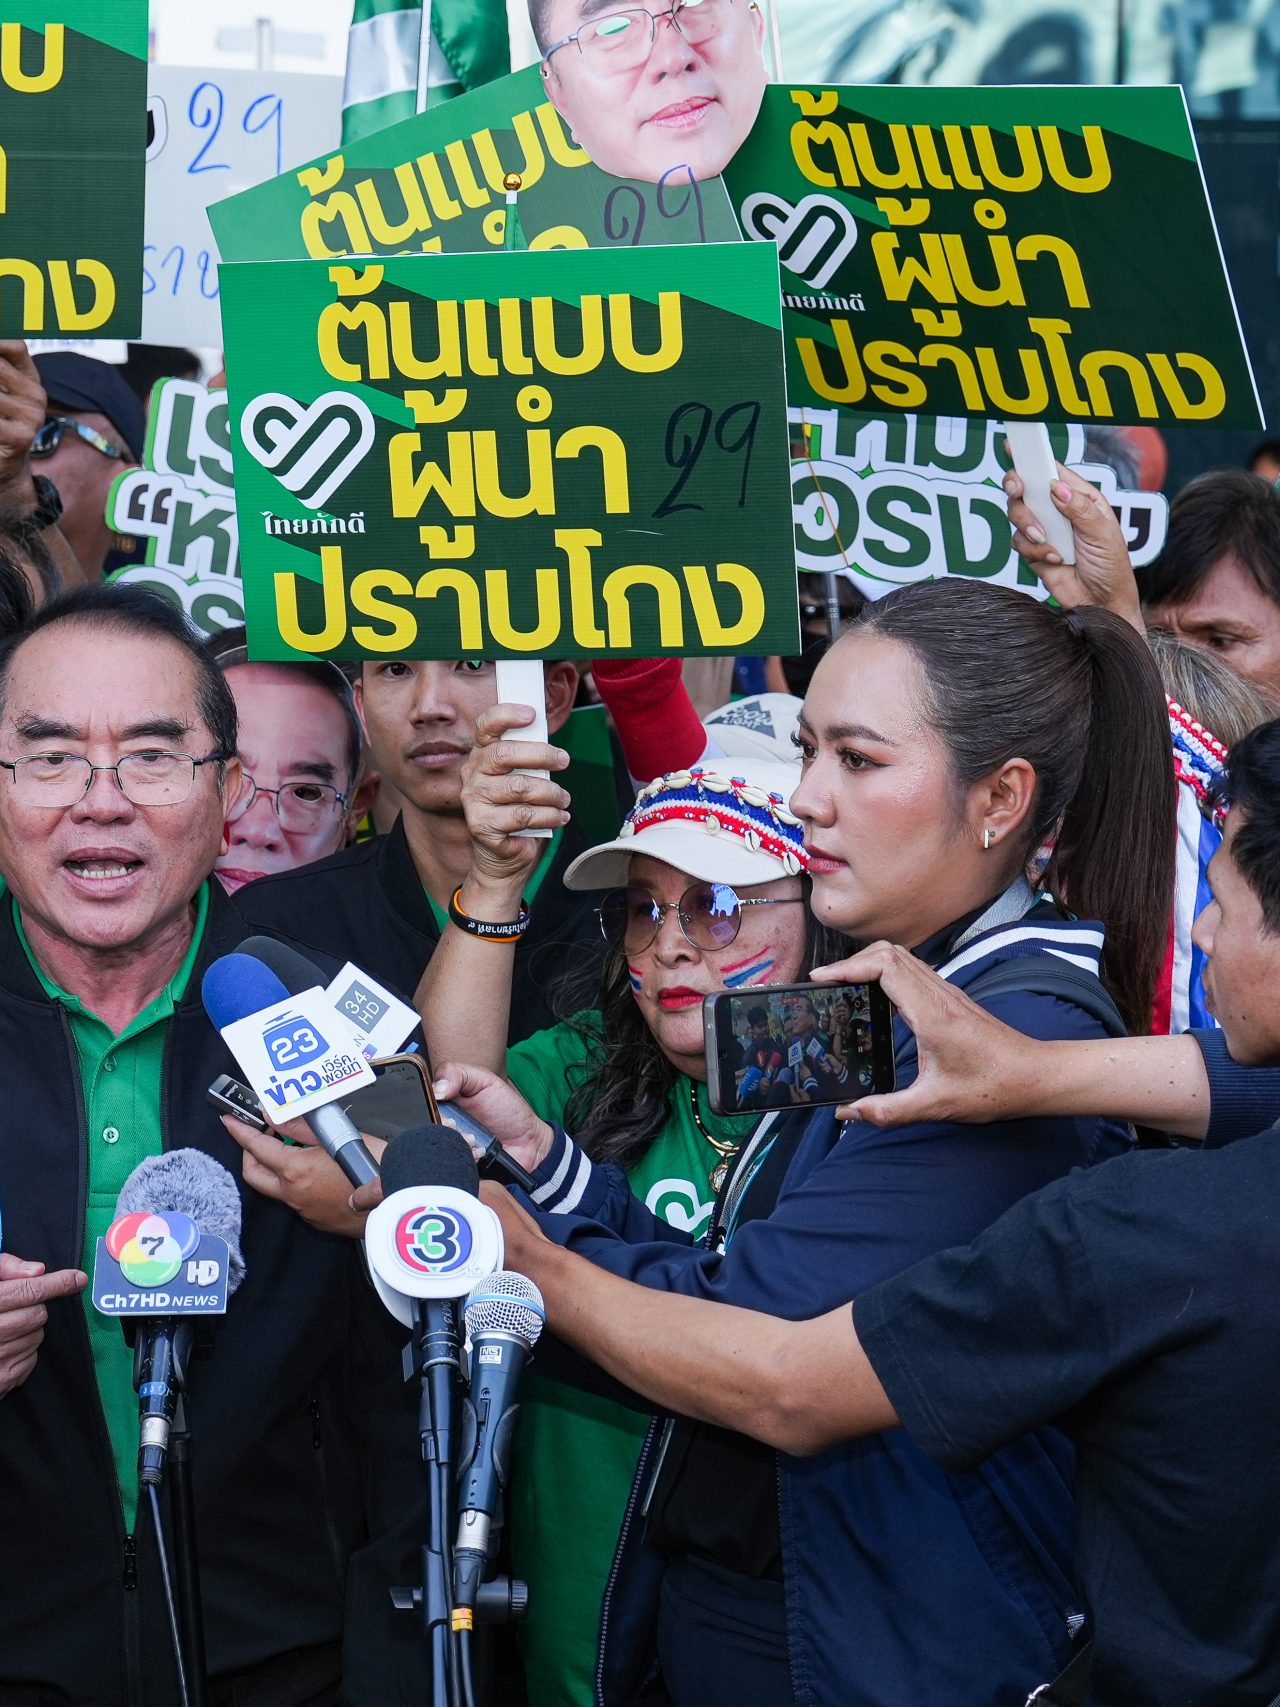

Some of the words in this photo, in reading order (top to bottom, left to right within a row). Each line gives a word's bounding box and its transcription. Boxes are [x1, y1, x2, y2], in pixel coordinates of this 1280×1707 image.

[187, 82, 282, 176] 29
[790, 90, 1112, 193] ต้นแบบ
[871, 197, 1091, 337] ผู้นำ
[318, 264, 683, 382] ต้นแบบ
[796, 317, 1226, 420] ปราบโกง
[389, 385, 630, 559] ผู้นำ
[652, 401, 761, 518] 29
[260, 511, 366, 534] ไทยภักดี
[273, 528, 766, 653] ปราบโกง
[345, 990, 368, 1014] 34
[358, 1001, 380, 1025] HD
[271, 1027, 319, 1064] 23
[264, 1070, 324, 1106] ข่าว
[141, 1236, 165, 1256] 7
[410, 1213, 458, 1265] 3
[186, 1259, 220, 1287] HD
[100, 1293, 171, 1308] Ch7HD
[171, 1295, 219, 1307] NEWS
